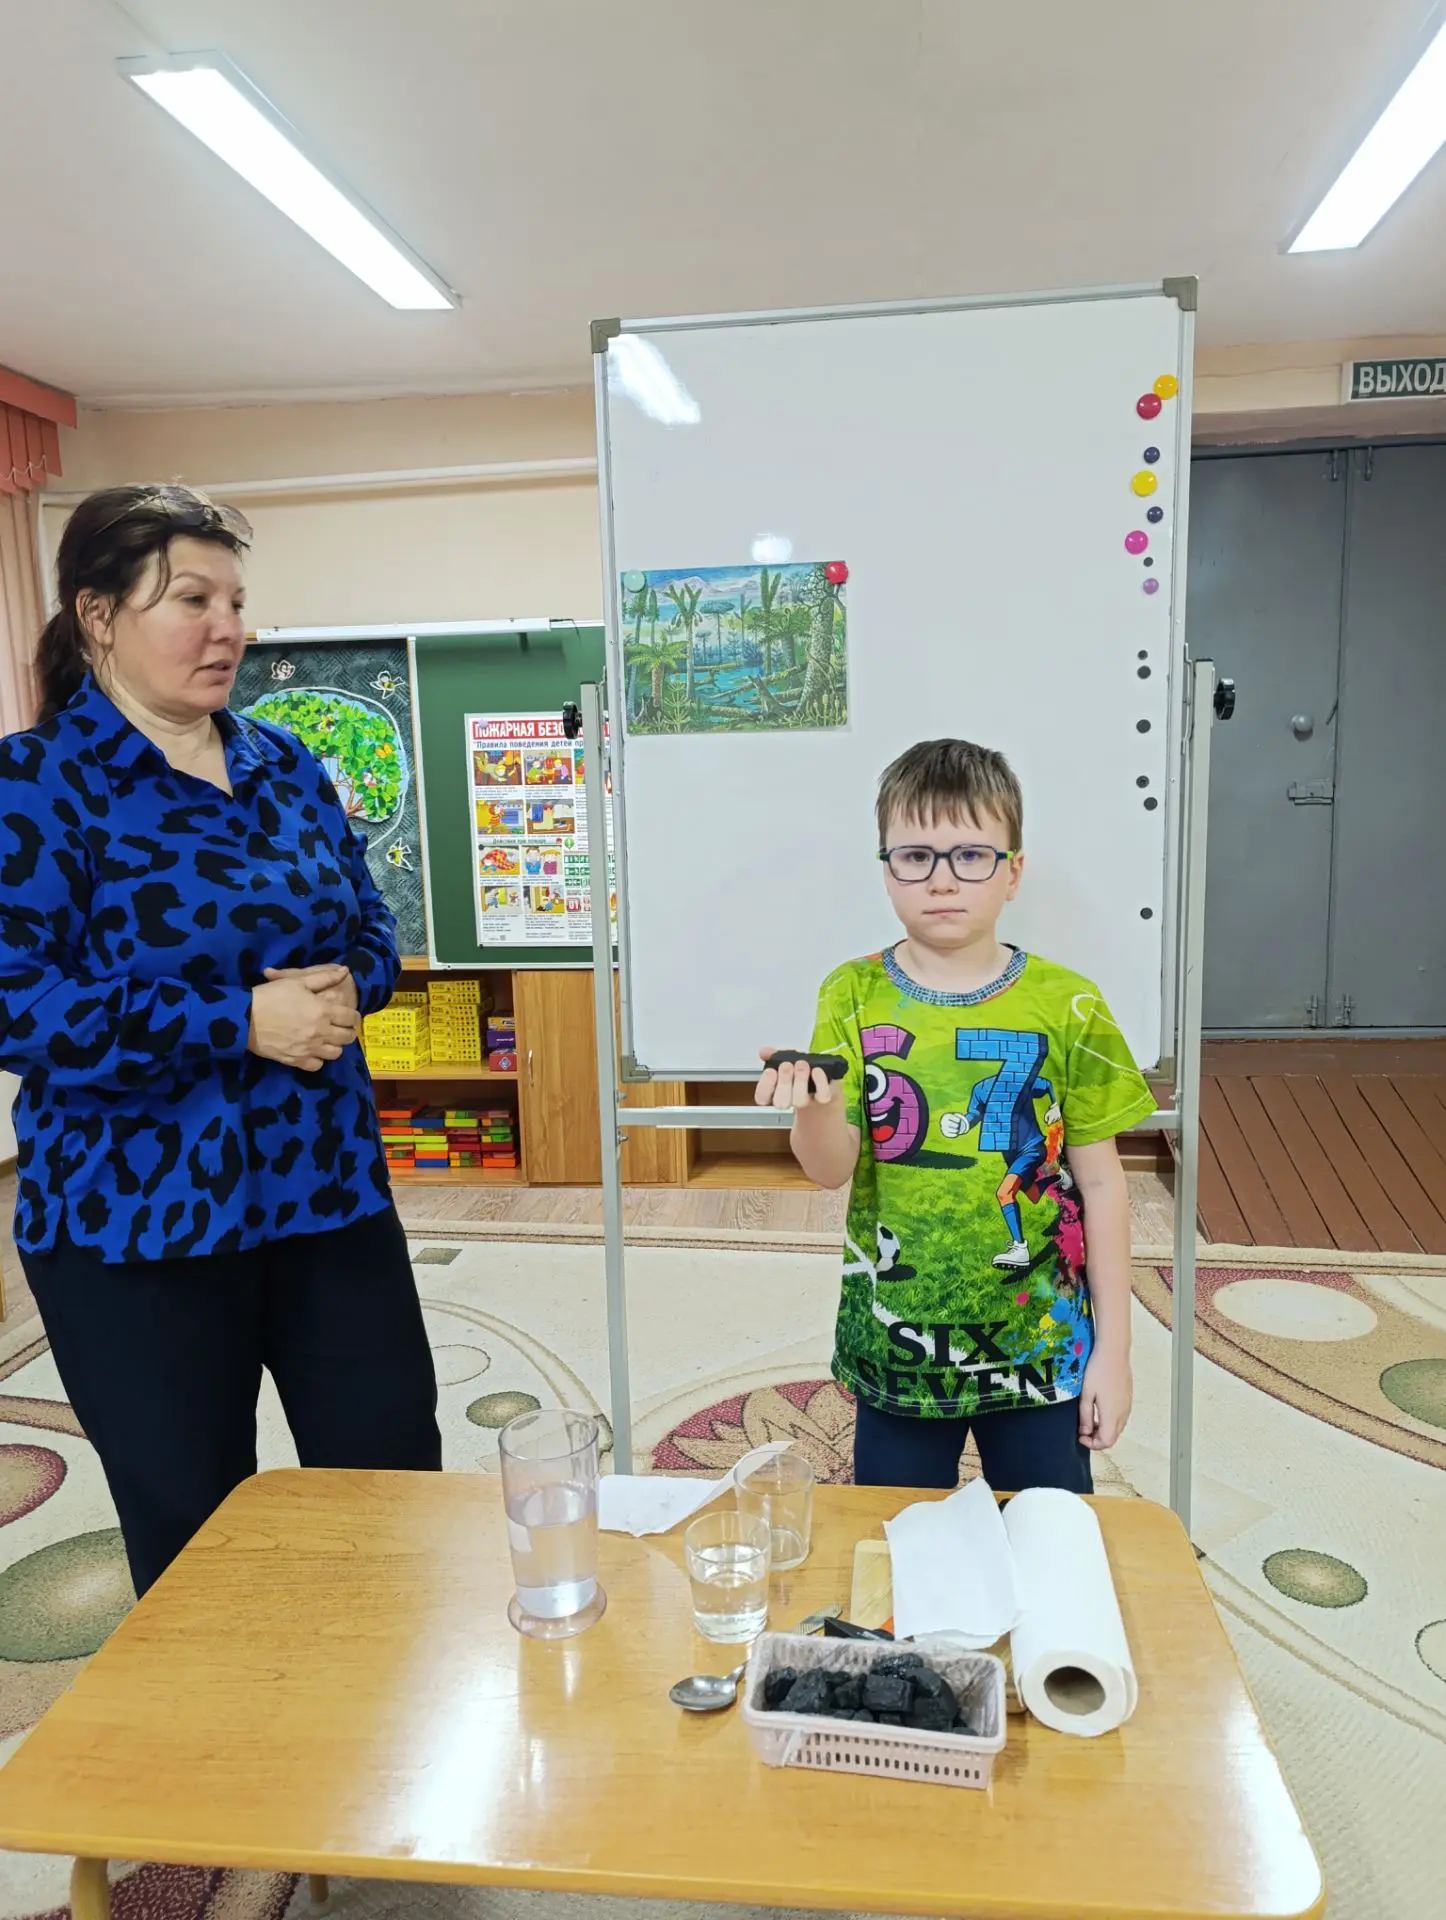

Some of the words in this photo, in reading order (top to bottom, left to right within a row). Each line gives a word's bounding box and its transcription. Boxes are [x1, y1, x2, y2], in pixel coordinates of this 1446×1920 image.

[1359, 363, 1446, 393] ВЫХОД
[475, 721, 535, 738] ПОЖАРНАЯ
[509, 740, 549, 748] поведения
[887, 1320, 1011, 1367] SIX
[855, 1357, 1057, 1414] SEVEN
